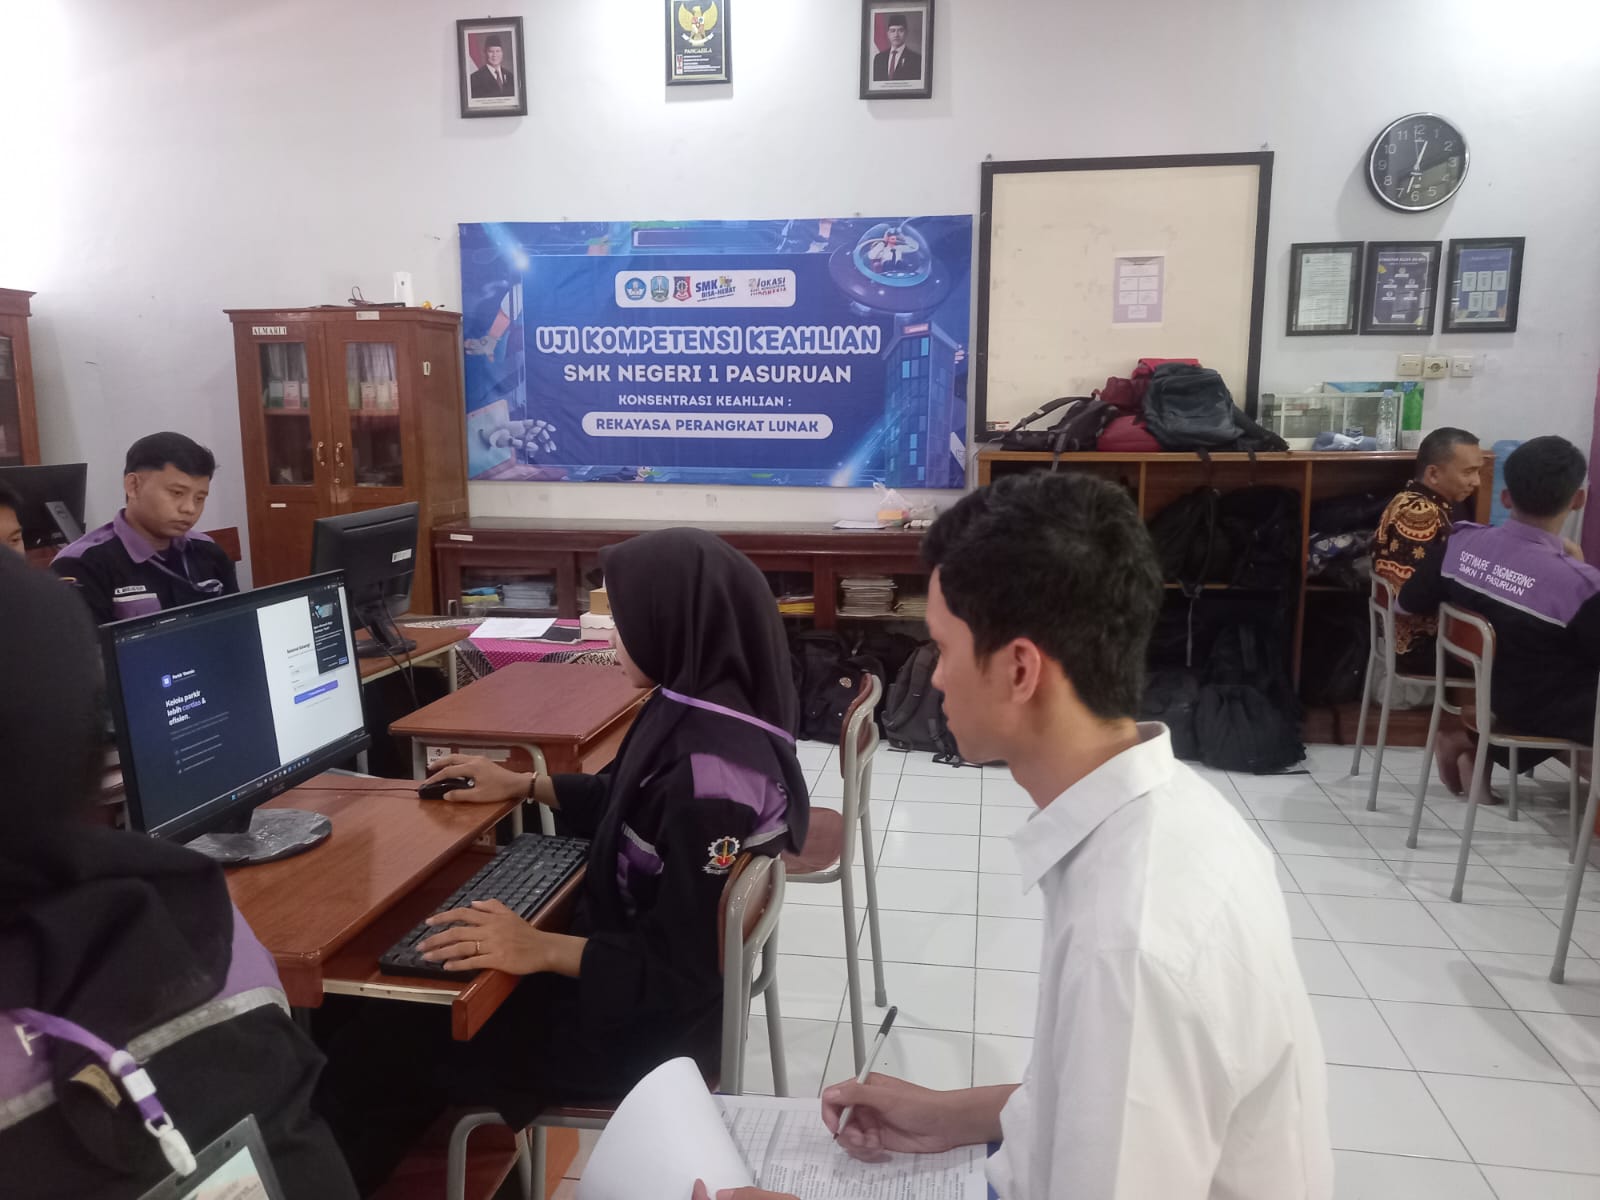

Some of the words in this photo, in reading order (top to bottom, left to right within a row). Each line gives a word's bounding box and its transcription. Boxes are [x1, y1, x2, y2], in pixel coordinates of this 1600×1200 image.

[1414, 124, 1425, 135] 12
[1434, 129, 1439, 139] 1
[1398, 130, 1408, 141] 11
[1384, 144, 1397, 154] 10
[1444, 141, 1453, 151] 2
[1378, 160, 1387, 170] 9
[1448, 157, 1457, 167] 3
[1384, 176, 1393, 186] 8
[1396, 187, 1404, 198] 7
[1411, 191, 1420, 202] 6
[1428, 186, 1437, 197] 5
[696, 278, 718, 292] SMK
[537, 327, 578, 353] UJI
[583, 327, 741, 354] KOMPETENSI
[747, 326, 881, 354] KEAHLIAN
[564, 364, 611, 382] SMK
[618, 365, 702, 383] NEGERI
[709, 365, 719, 383] 1
[727, 365, 852, 384] PASURUAN
[618, 395, 712, 406] KONSENTRASI
[716, 396, 784, 407] KEAHLIAN
[596, 418, 671, 431] REKAYASA
[676, 419, 765, 432] PERANGKAT
[768, 420, 819, 433] LUNAK
[1460, 551, 1491, 571] SOFTWARE
[1459, 563, 1477, 578] SMKN
[1485, 574, 1525, 596] PASURUAN
